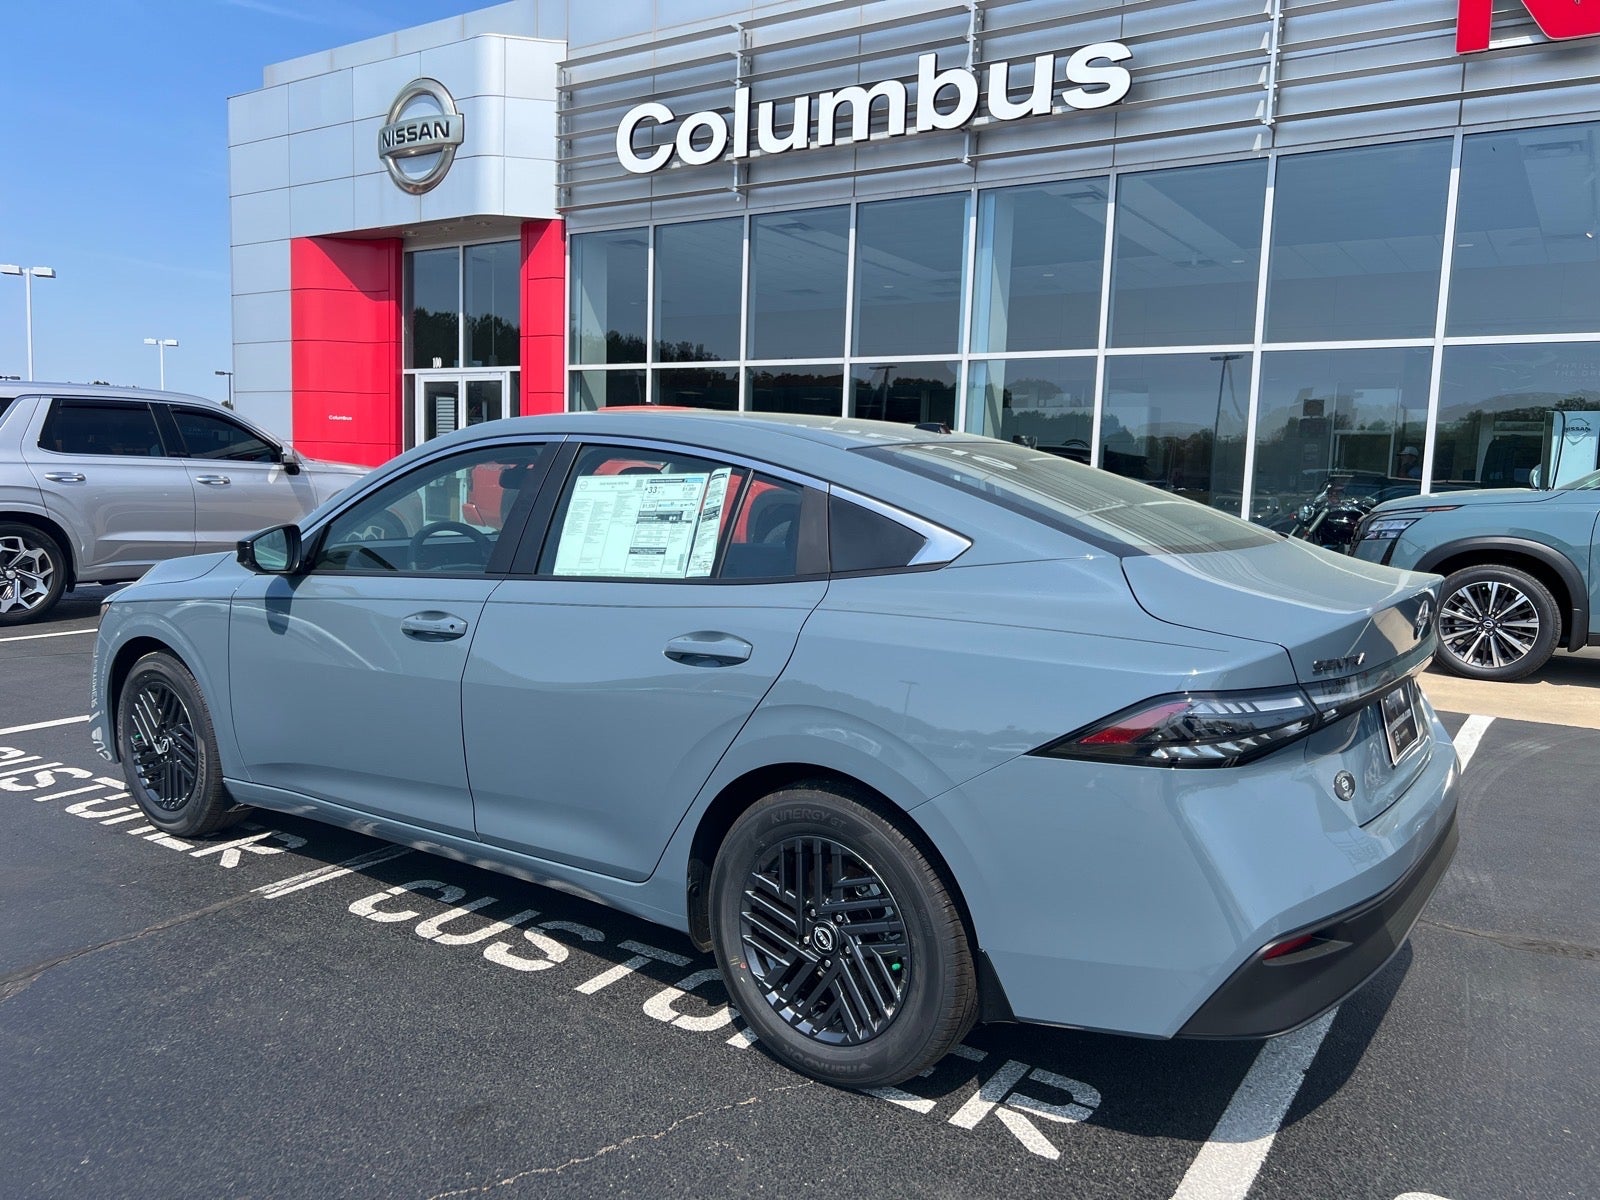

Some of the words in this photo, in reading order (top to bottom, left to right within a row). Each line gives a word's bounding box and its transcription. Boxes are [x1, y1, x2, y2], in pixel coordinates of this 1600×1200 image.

[382, 121, 450, 149] NISSAN
[615, 41, 1133, 173] Columbus
[348, 879, 1102, 1160] CUSTOR
